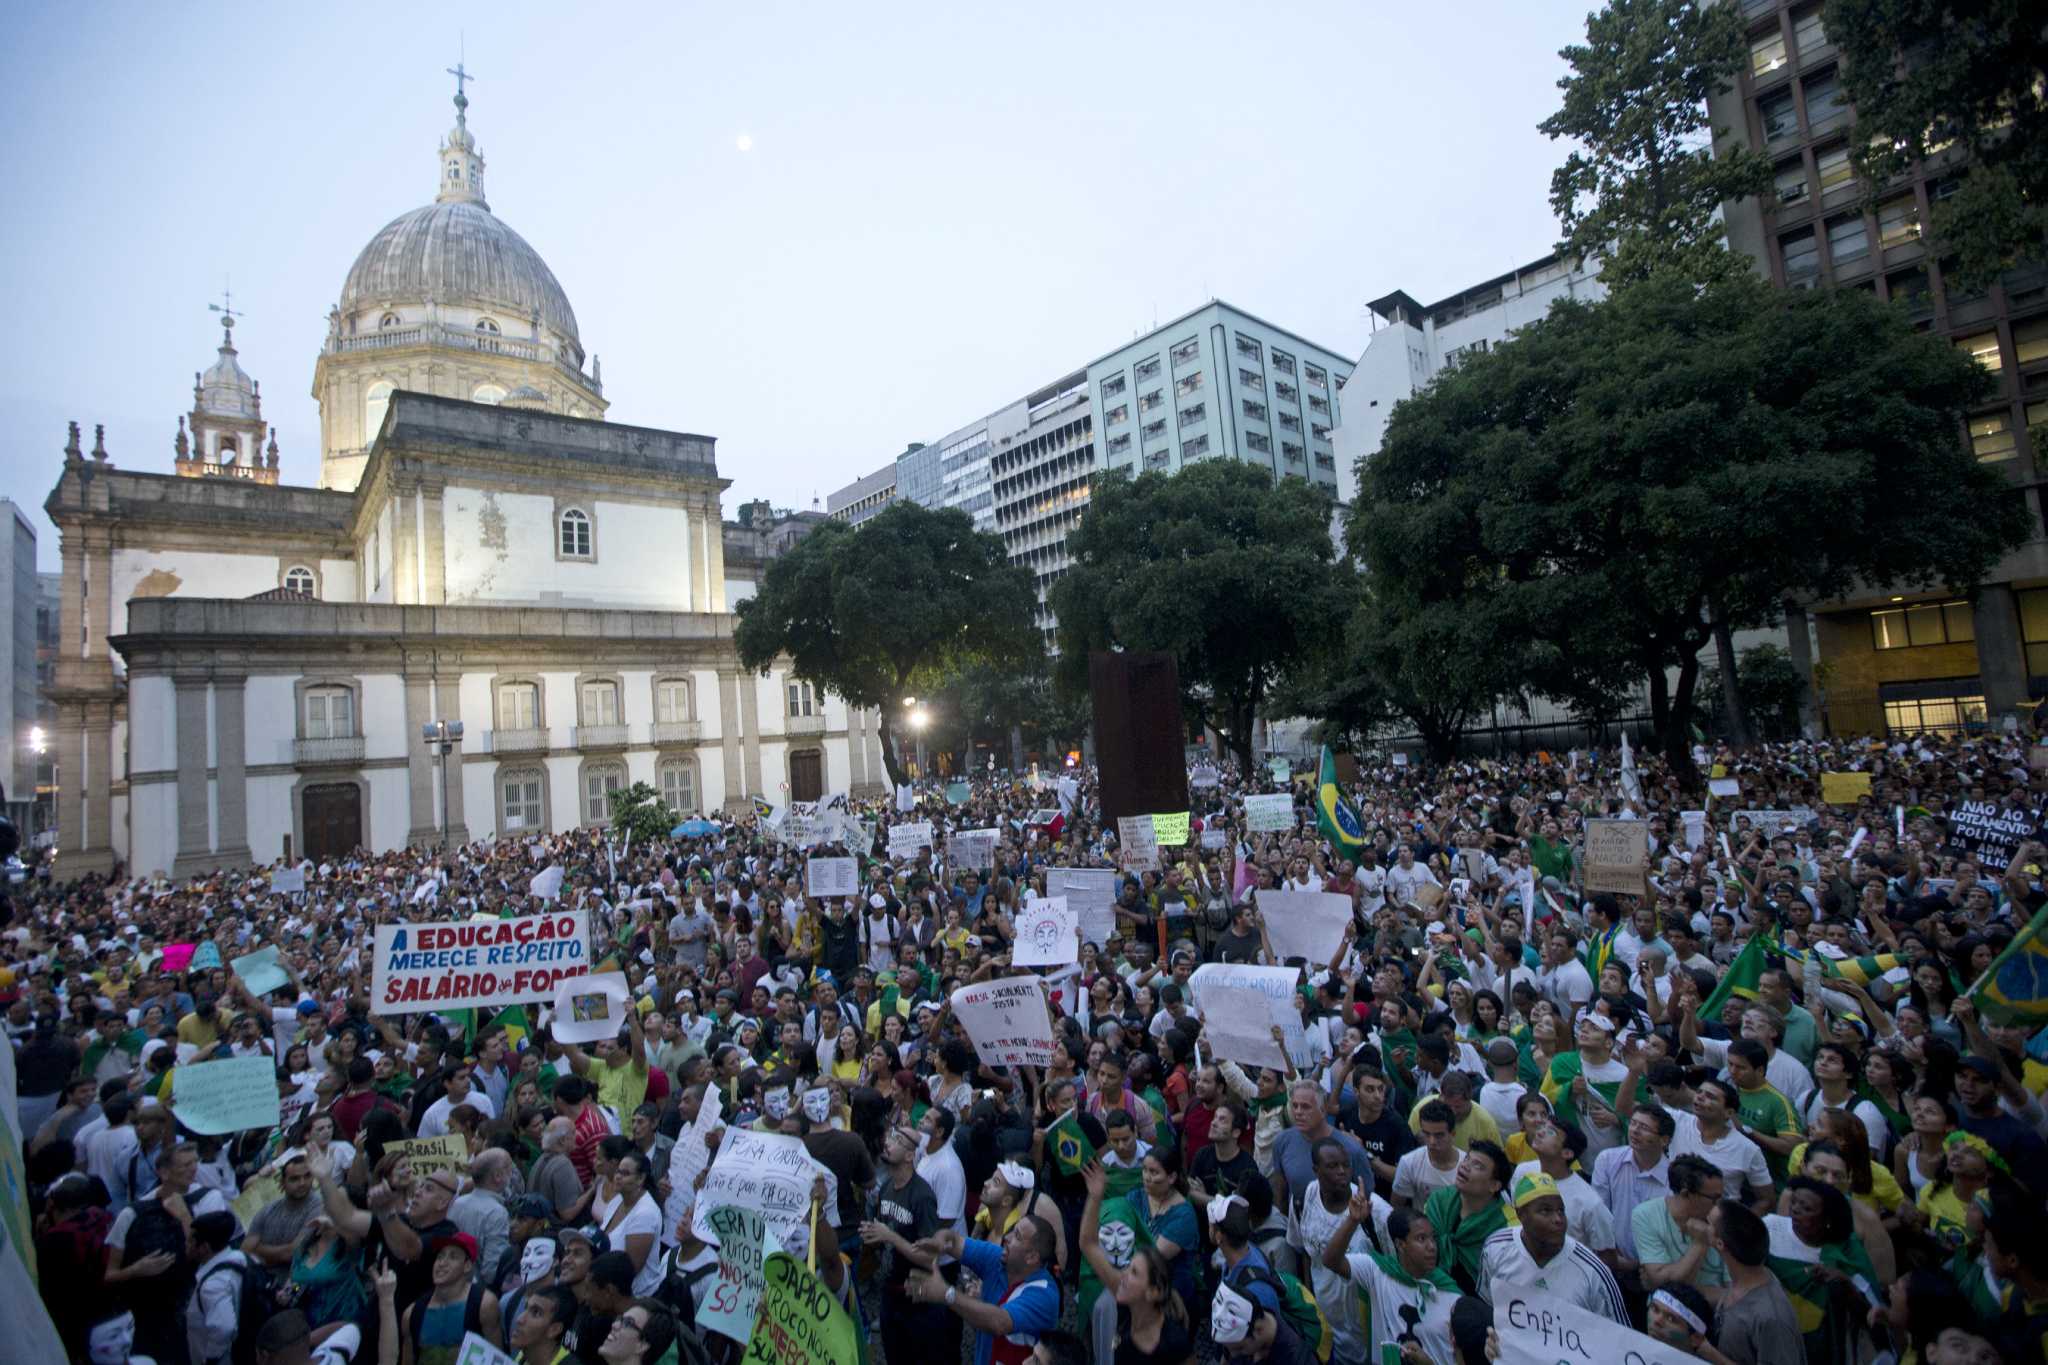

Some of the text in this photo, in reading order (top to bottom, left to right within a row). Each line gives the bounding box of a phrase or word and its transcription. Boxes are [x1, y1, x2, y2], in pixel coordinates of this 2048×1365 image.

[1950, 810, 2031, 836] LOTEAMENTO
[2001, 808, 2023, 821] AO
[1950, 837, 1966, 849] DA
[1956, 824, 2020, 847] POLÍTICO
[390, 915, 575, 951] A EDUCAÇÃO
[388, 940, 584, 970] MERECE RESPEITO.
[728, 1135, 765, 1161] FORA
[1366, 1140, 1385, 1152] not
[711, 1209, 746, 1238] ERA
[752, 1217, 765, 1243] U
[720, 1237, 750, 1265] MUITO
[754, 1250, 763, 1271] B
[709, 1284, 742, 1314] SÓ
[764, 1254, 831, 1321] JAPÃO
[1508, 1299, 1591, 1359] Enfia
